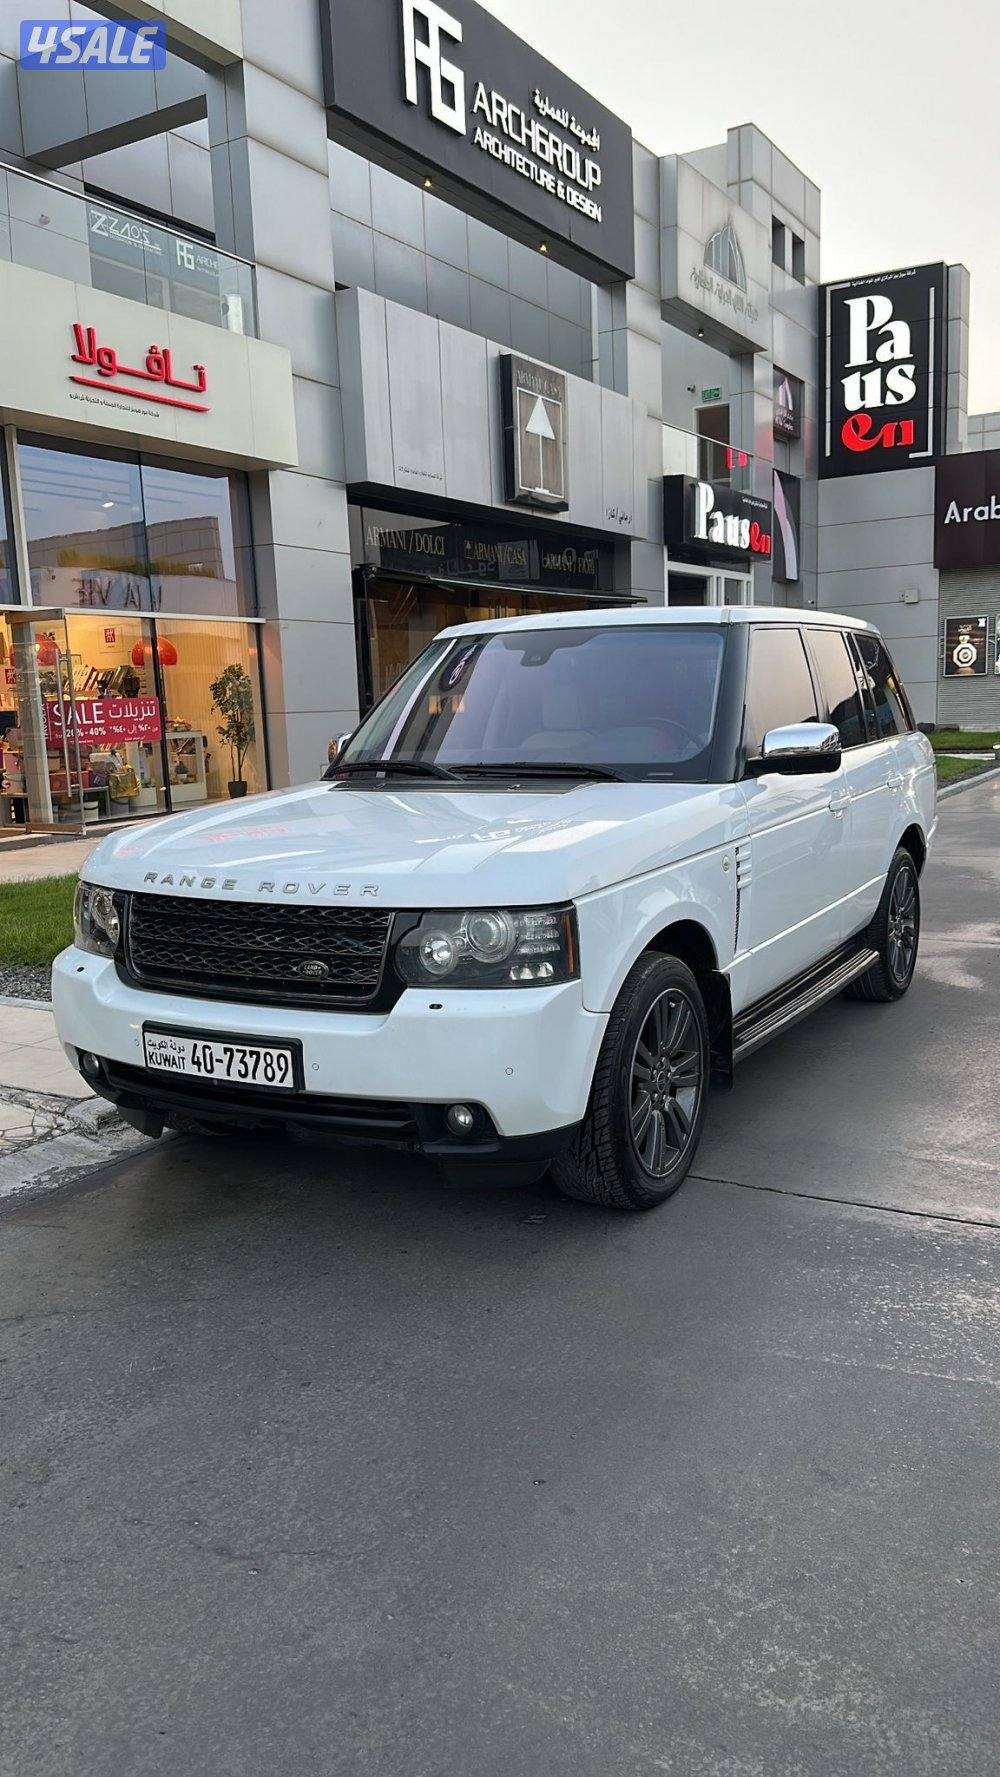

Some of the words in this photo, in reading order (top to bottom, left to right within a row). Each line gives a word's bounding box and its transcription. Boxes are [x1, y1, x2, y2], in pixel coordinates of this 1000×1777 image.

[472, 82, 601, 192] ARCHGROUP
[474, 126, 556, 194] ARCHITECTURE
[556, 179, 566, 201] &
[566, 185, 602, 223] DESIGN
[944, 495, 1000, 524] Arab
[53, 702, 106, 726] SALE
[108, 700, 156, 721] تنزيلات
[143, 870, 238, 891] RANGE
[257, 880, 381, 898] ROVER
[147, 1039, 168, 1051] الكويت
[169, 1039, 185, 1054] دولة
[148, 1051, 186, 1070] KUWAIT
[191, 1043, 289, 1083] 40-73789
